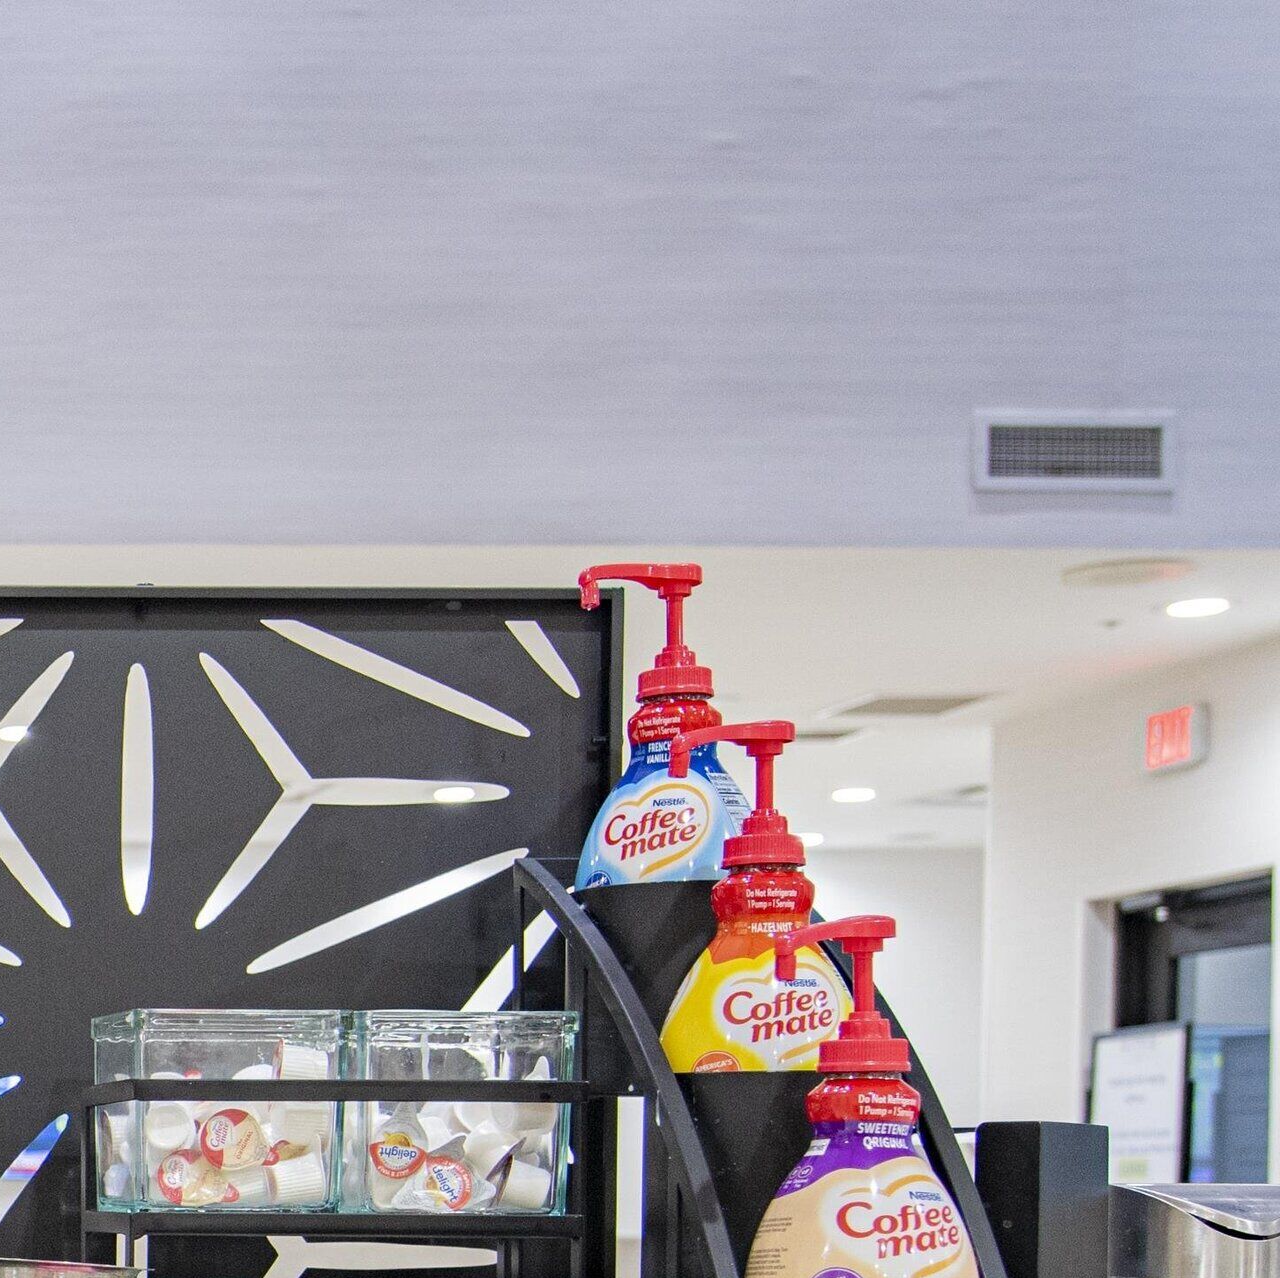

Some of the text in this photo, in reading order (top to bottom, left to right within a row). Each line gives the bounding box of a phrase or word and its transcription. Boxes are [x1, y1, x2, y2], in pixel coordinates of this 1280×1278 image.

[647, 753, 670, 764] VANILL
[604, 808, 695, 846] Coffee
[620, 824, 697, 861] mate
[751, 922, 793, 932] HAZELNUT
[723, 990, 827, 1025] Coffee
[751, 1008, 833, 1042] mate
[864, 1105, 887, 1117] Pump
[380, 1146, 417, 1160] delight
[863, 1136, 908, 1149] ORIGINAL
[432, 1166, 458, 1202] delight
[836, 1201, 953, 1238] Coffee
[877, 1225, 959, 1259] mate
